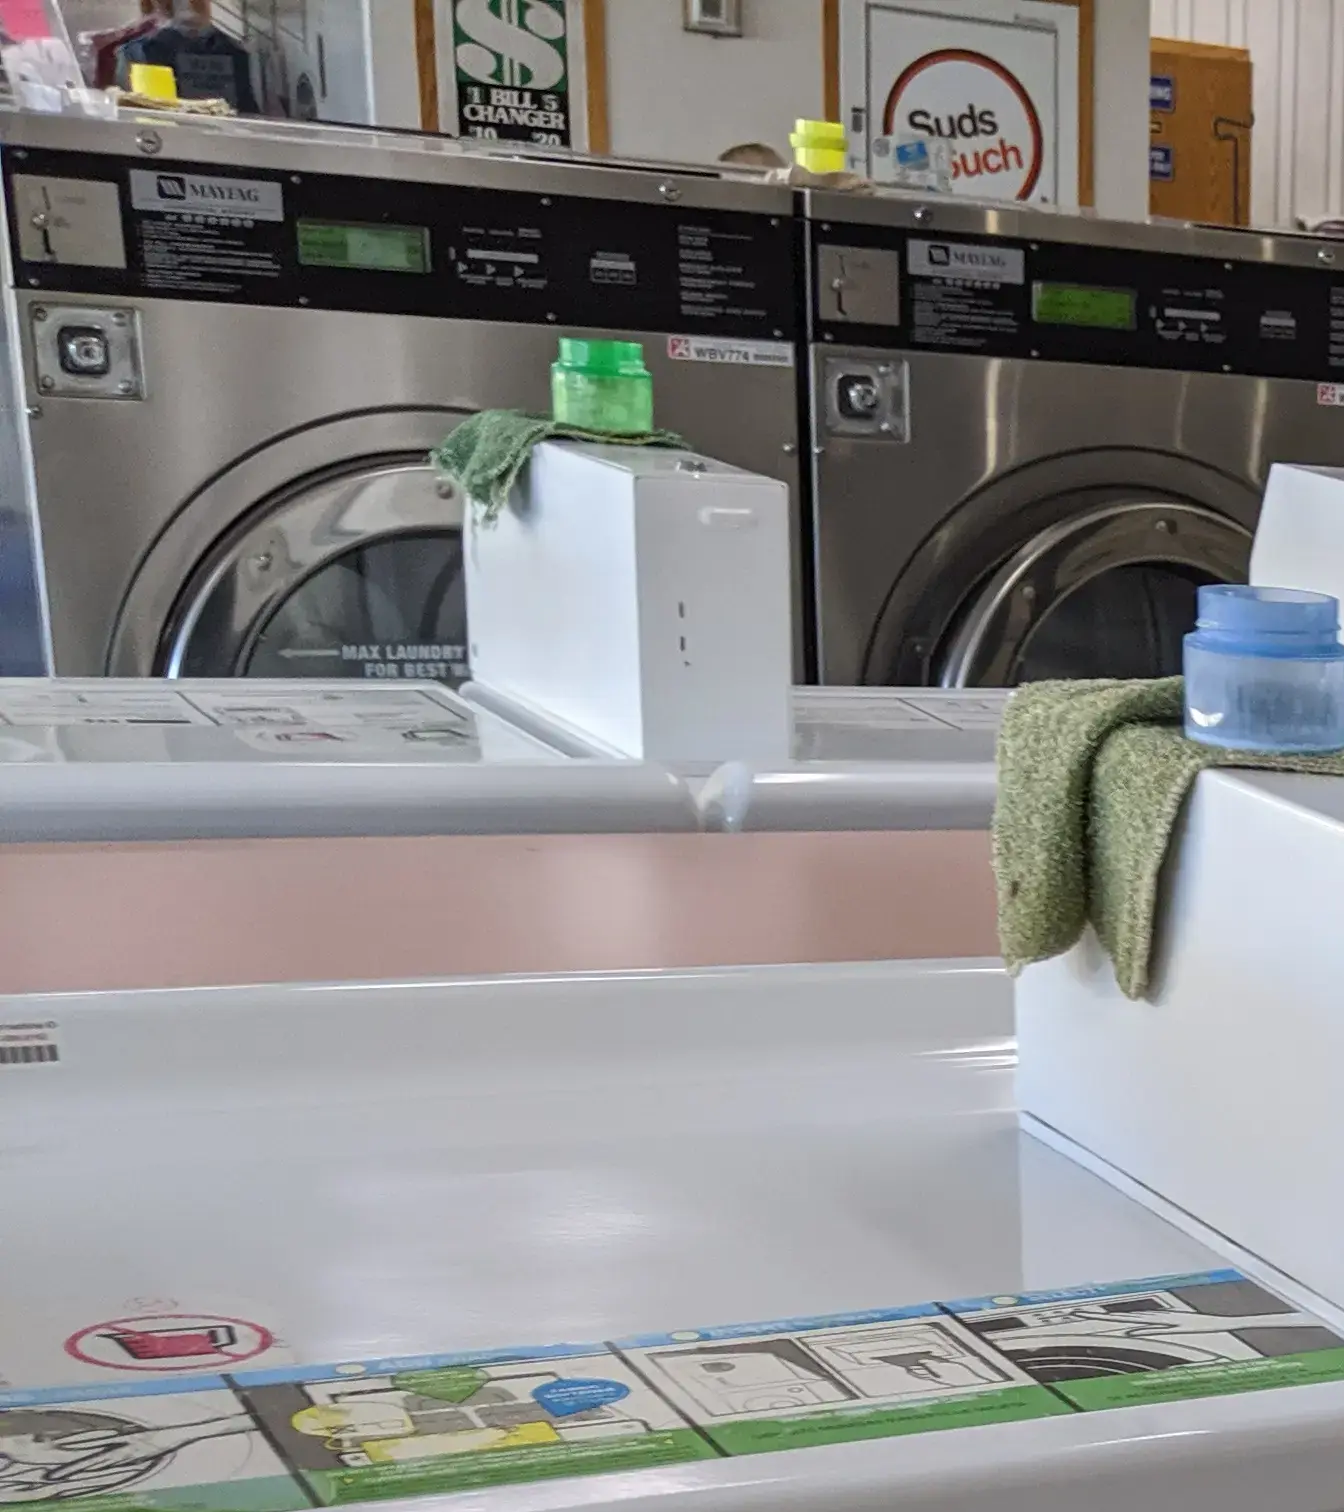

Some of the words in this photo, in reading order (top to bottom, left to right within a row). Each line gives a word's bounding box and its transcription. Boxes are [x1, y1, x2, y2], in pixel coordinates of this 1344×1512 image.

[490, 88, 538, 109] BILL
[463, 104, 565, 130] CHANGER
[908, 104, 998, 139] Suds
[190, 184, 260, 202] MAYTAG
[341, 644, 381, 660] MAX
[385, 645, 466, 660] LAUNDRY
[364, 662, 399, 678] FOR
[404, 663, 447, 678] BEST
